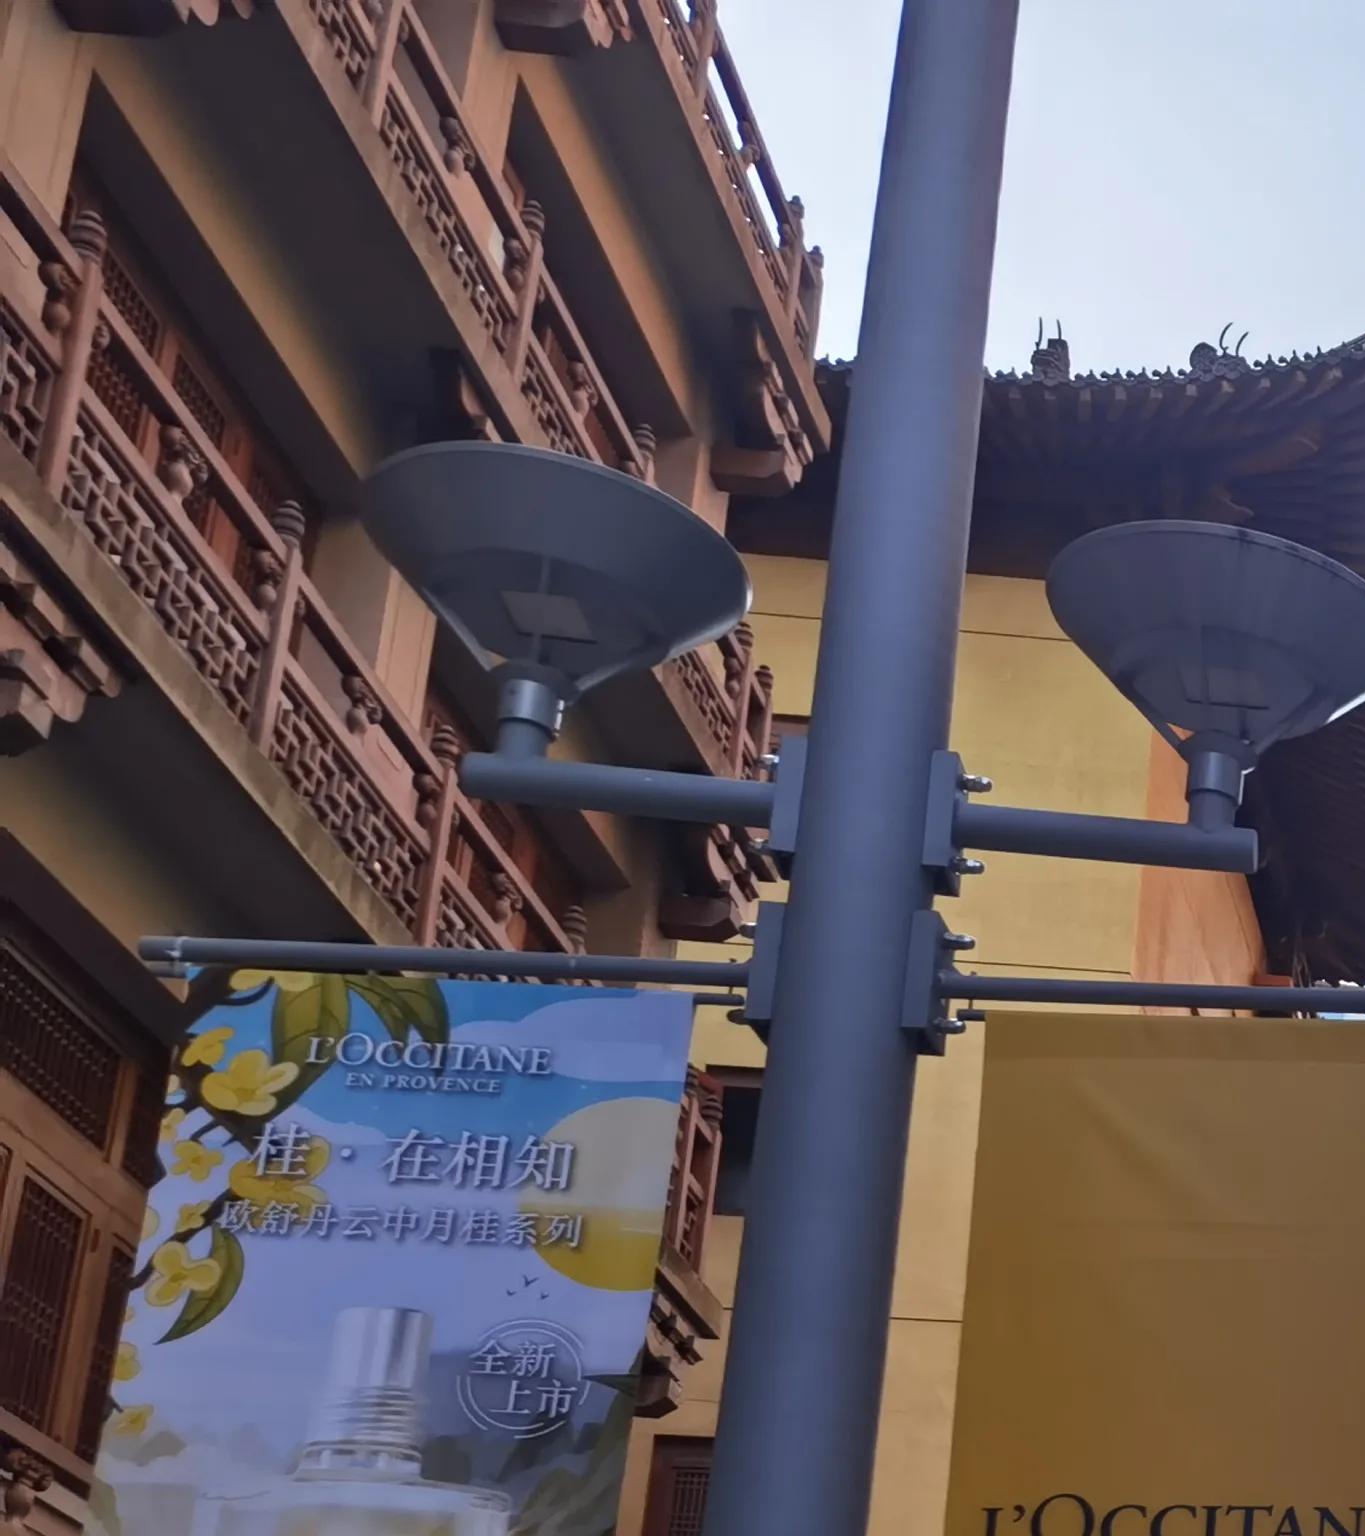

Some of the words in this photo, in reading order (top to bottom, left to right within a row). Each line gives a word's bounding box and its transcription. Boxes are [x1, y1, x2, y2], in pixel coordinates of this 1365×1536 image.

[305, 1033, 552, 1075] L'OCCITANE
[345, 1072, 373, 1088] EN
[383, 1074, 501, 1094] PROVENCE
[216, 1200, 583, 1248] 欧舒丹云中月桂系列
[469, 1339, 555, 1378] 全新
[490, 1379, 577, 1418] 上市
